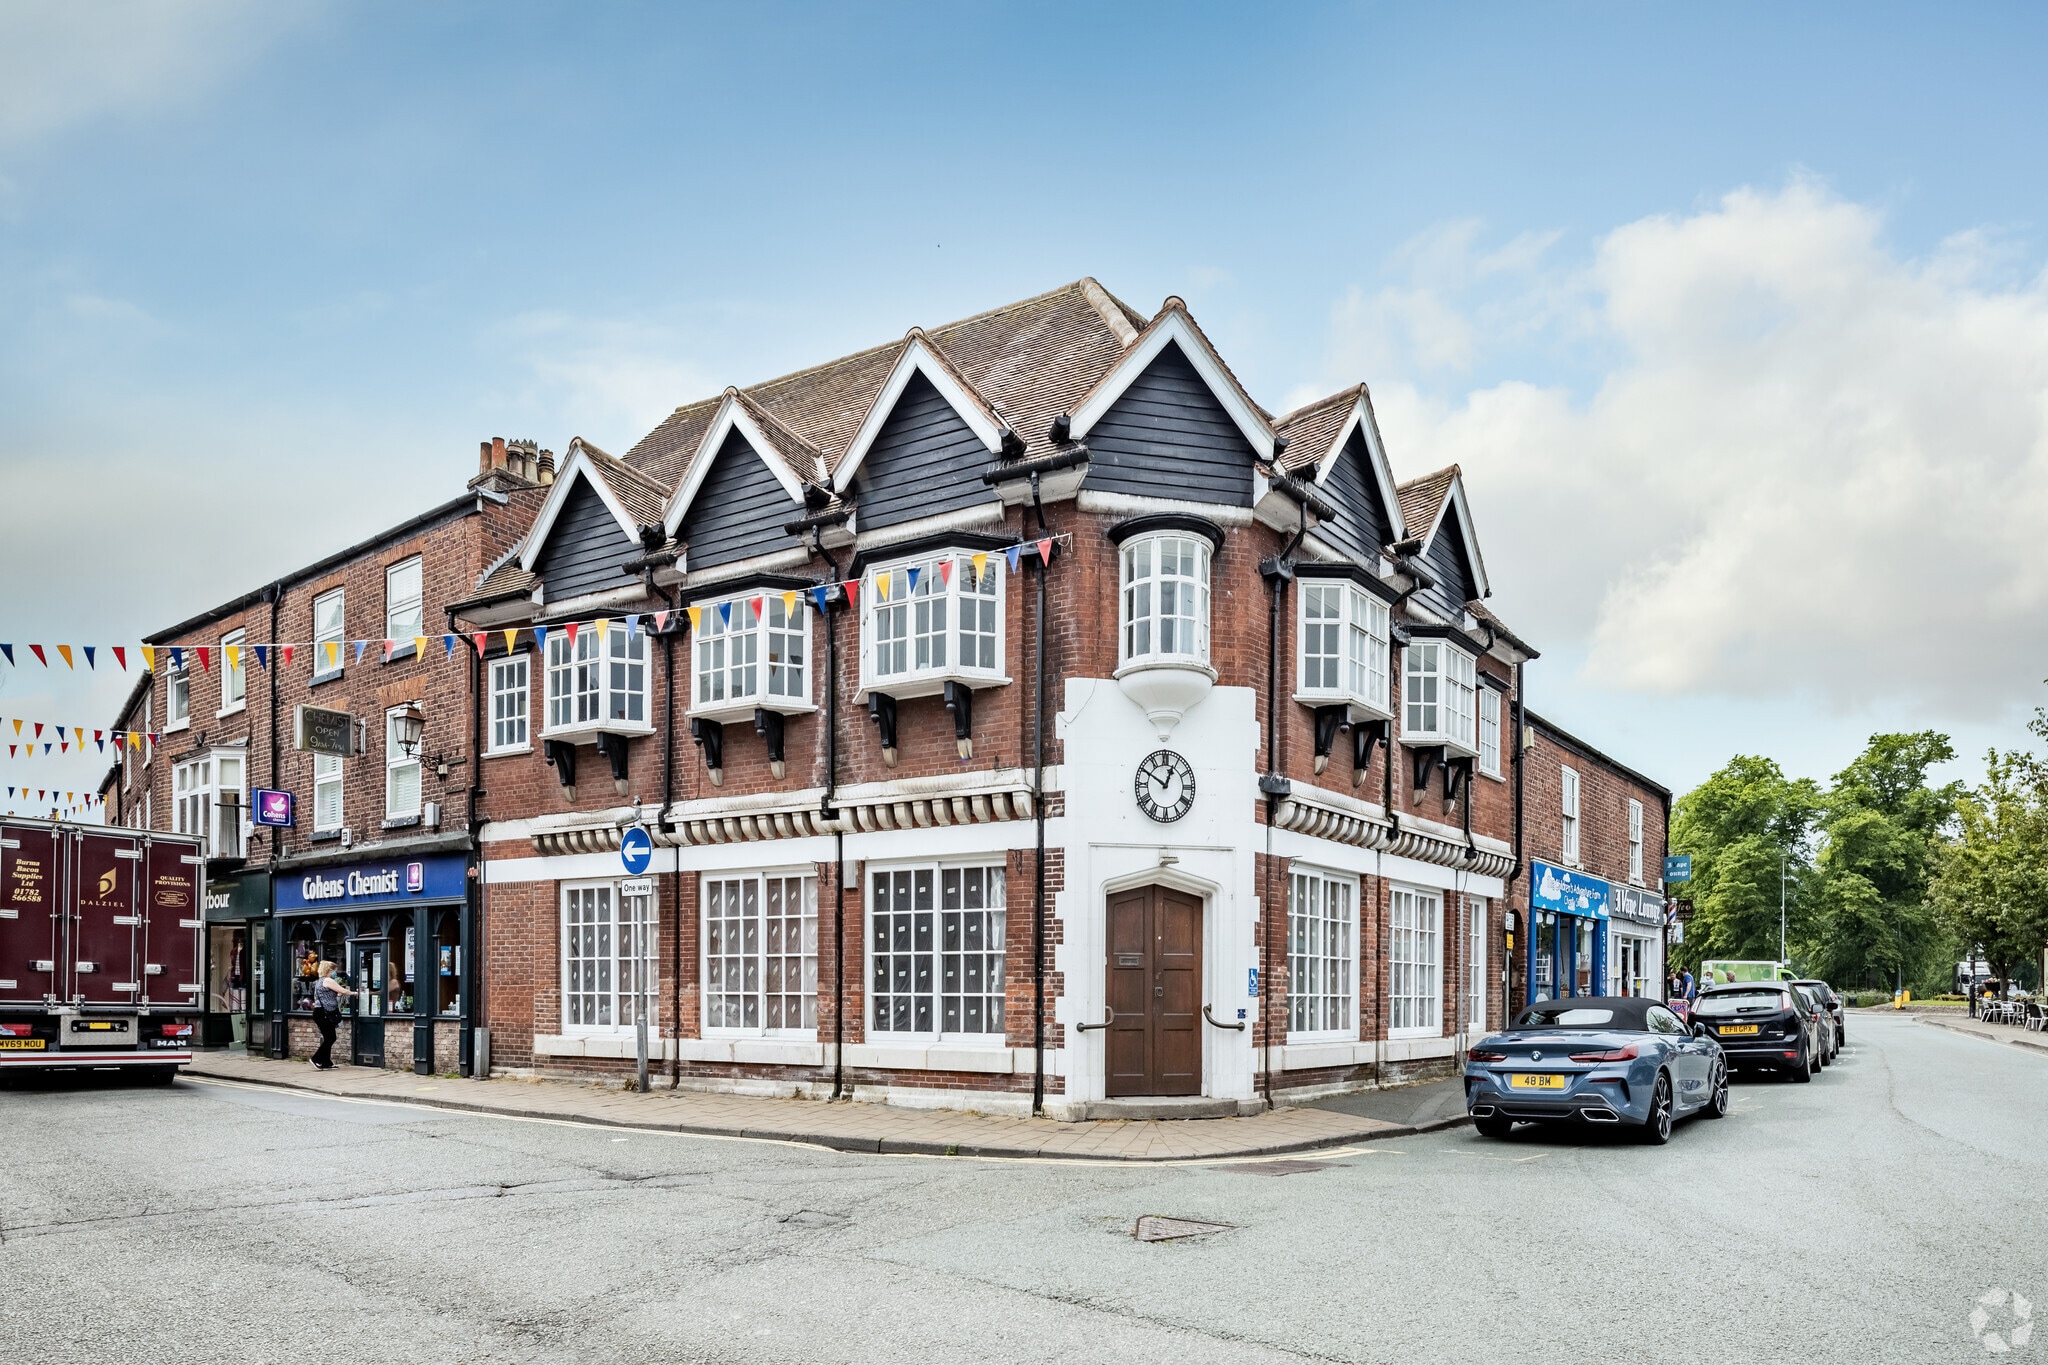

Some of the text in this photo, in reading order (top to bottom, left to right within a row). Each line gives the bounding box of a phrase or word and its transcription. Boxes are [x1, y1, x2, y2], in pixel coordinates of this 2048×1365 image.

[305, 710, 349, 728] CHEMIST
[315, 725, 339, 736] OPEN
[263, 810, 286, 819] Cohens
[16, 858, 40, 866] Burma
[16, 865, 39, 873] Bacon
[12, 872, 43, 880] Supplies
[303, 869, 399, 900] Cohens Chemist
[624, 883, 636, 892] One
[14, 888, 40, 896] 01782
[12, 894, 42, 902] 566588
[205, 889, 230, 910] rbour
[80, 899, 125, 908] DALZIEL
[1638, 893, 1661, 924] Lounge
[1524, 1076, 1551, 1086] 48 BM
